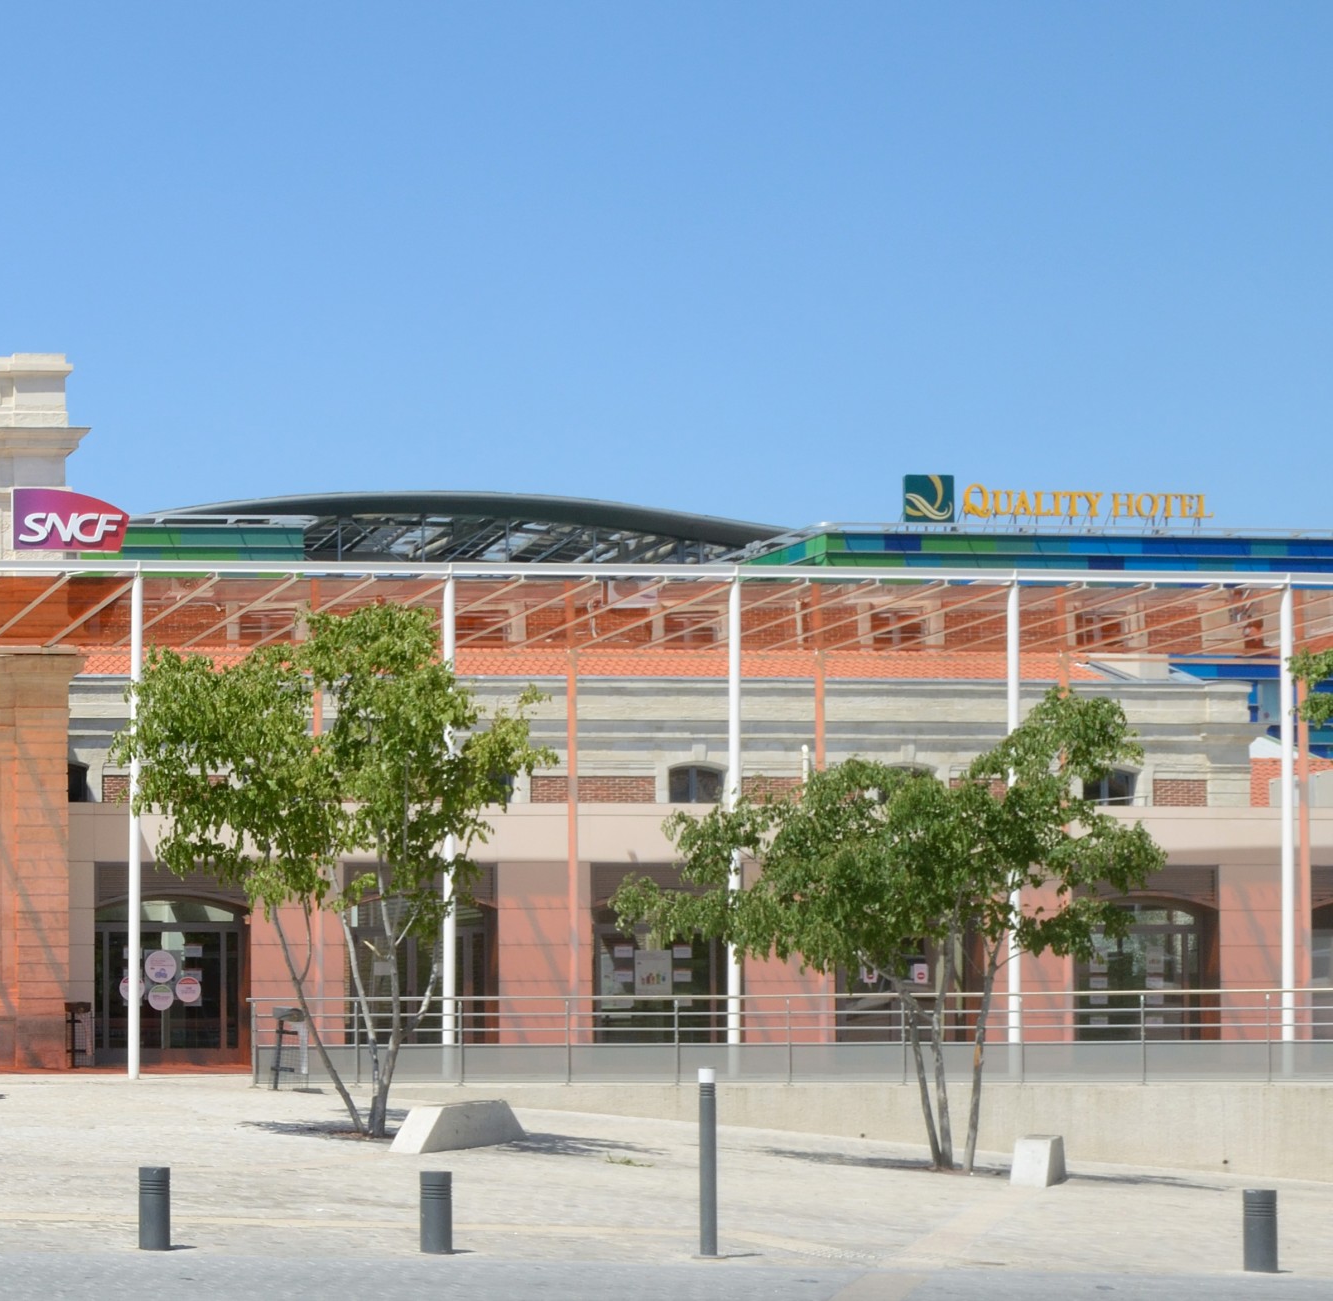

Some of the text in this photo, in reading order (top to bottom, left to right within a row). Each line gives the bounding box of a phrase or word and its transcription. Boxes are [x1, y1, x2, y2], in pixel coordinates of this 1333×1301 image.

[963, 483, 1214, 518] QUALITY HOTEL
[18, 512, 123, 543] SNCF
